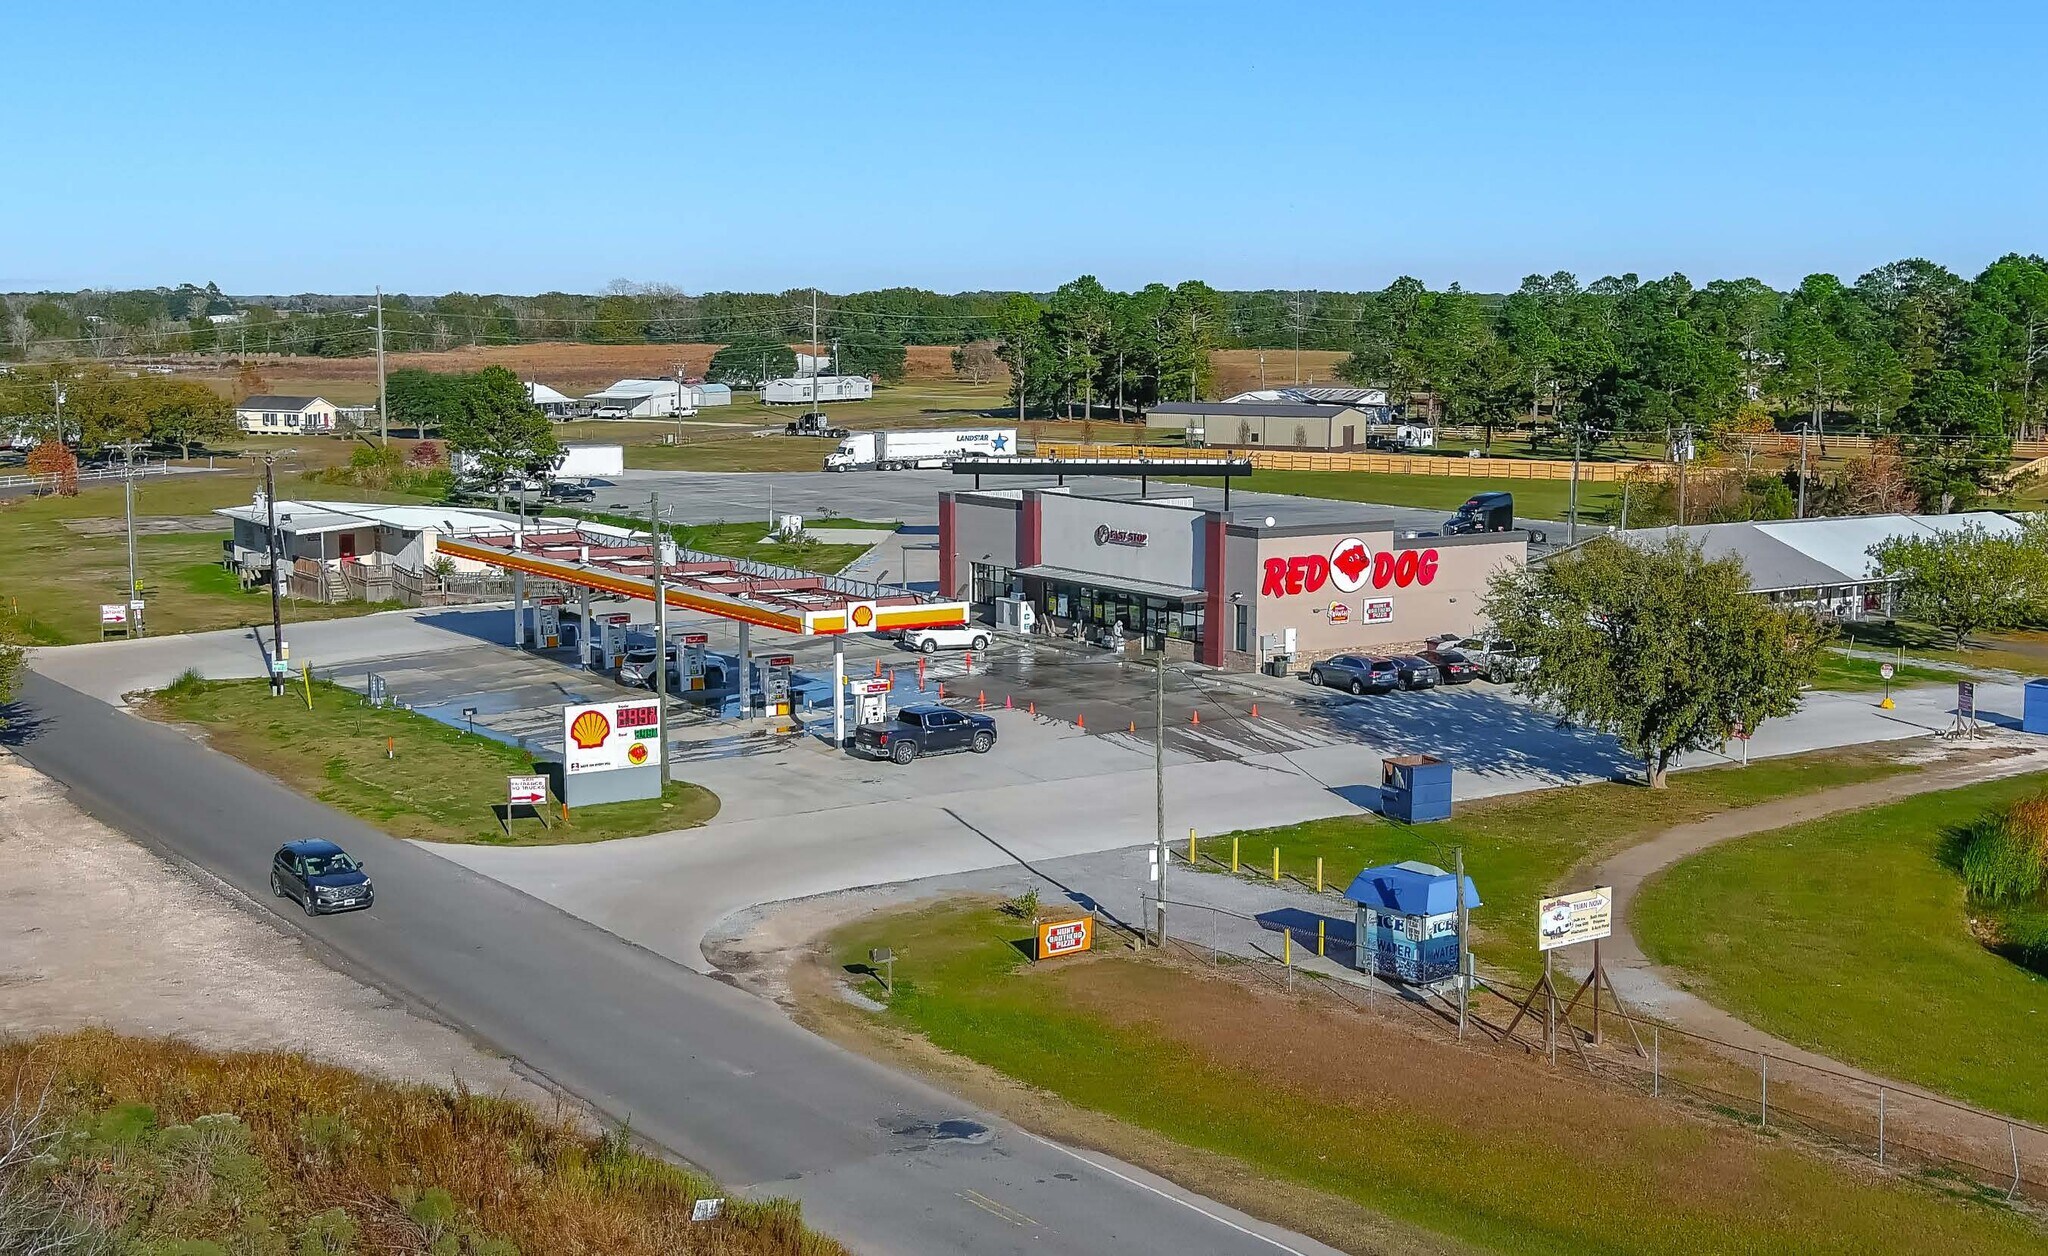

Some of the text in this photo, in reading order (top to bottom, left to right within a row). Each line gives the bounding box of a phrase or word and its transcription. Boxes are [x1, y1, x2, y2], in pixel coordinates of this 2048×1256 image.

[956, 434, 989, 442] LANDSTAR
[1128, 532, 1148, 543] STOP
[1261, 549, 1439, 599] RED DOG
[1588, 899, 1603, 908] NOW
[1377, 913, 1405, 933] ICE
[1056, 939, 1075, 948] PIZZA
[1377, 938, 1411, 958] WATER
